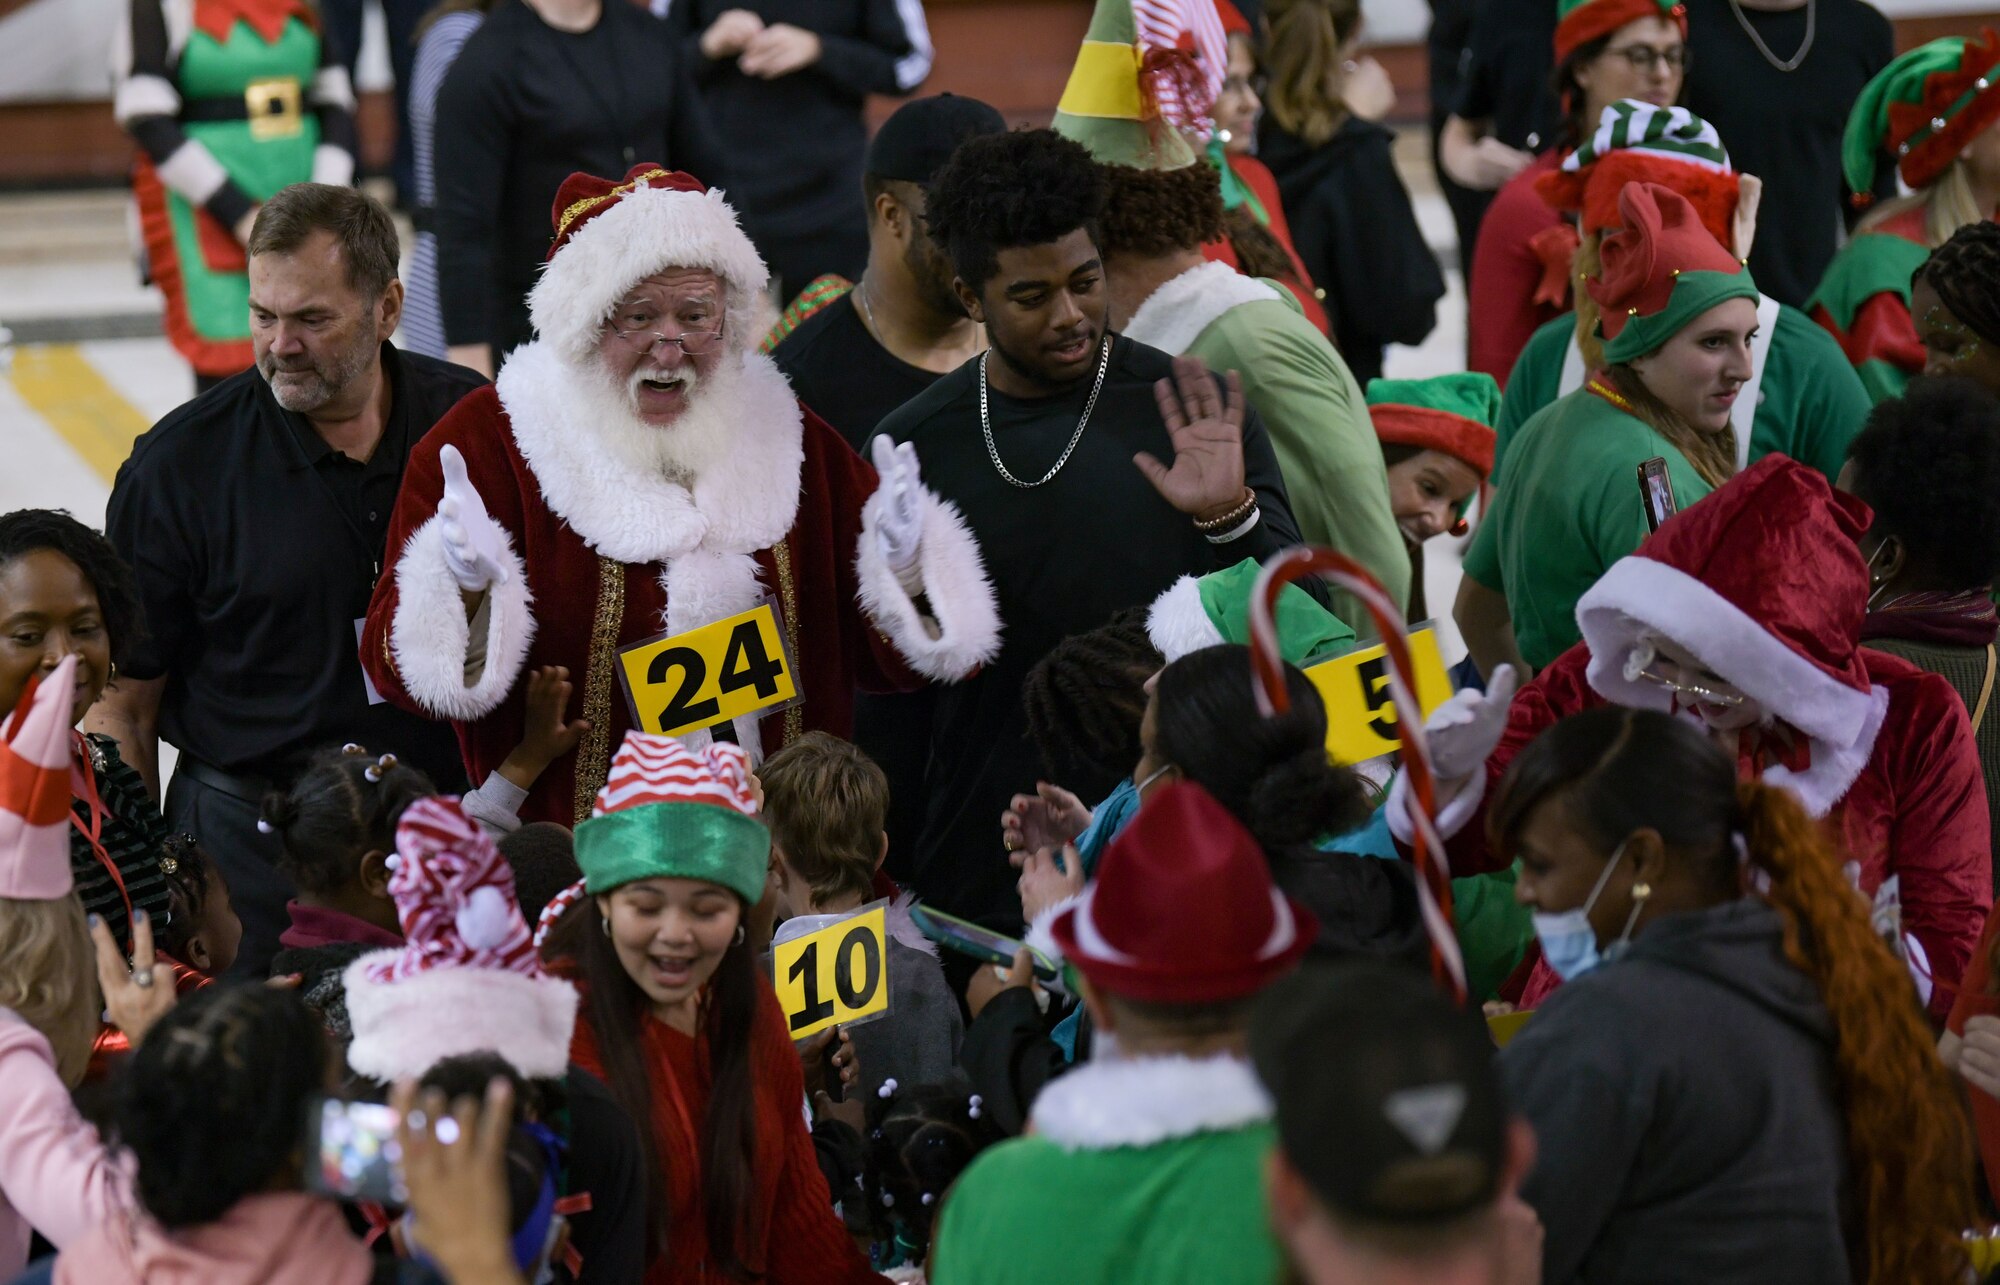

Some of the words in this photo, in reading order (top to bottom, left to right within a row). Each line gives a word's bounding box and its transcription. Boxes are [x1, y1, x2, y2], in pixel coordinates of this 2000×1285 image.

[647, 619, 784, 733] 24
[1357, 655, 1404, 741] 5
[788, 926, 881, 1032] 10
